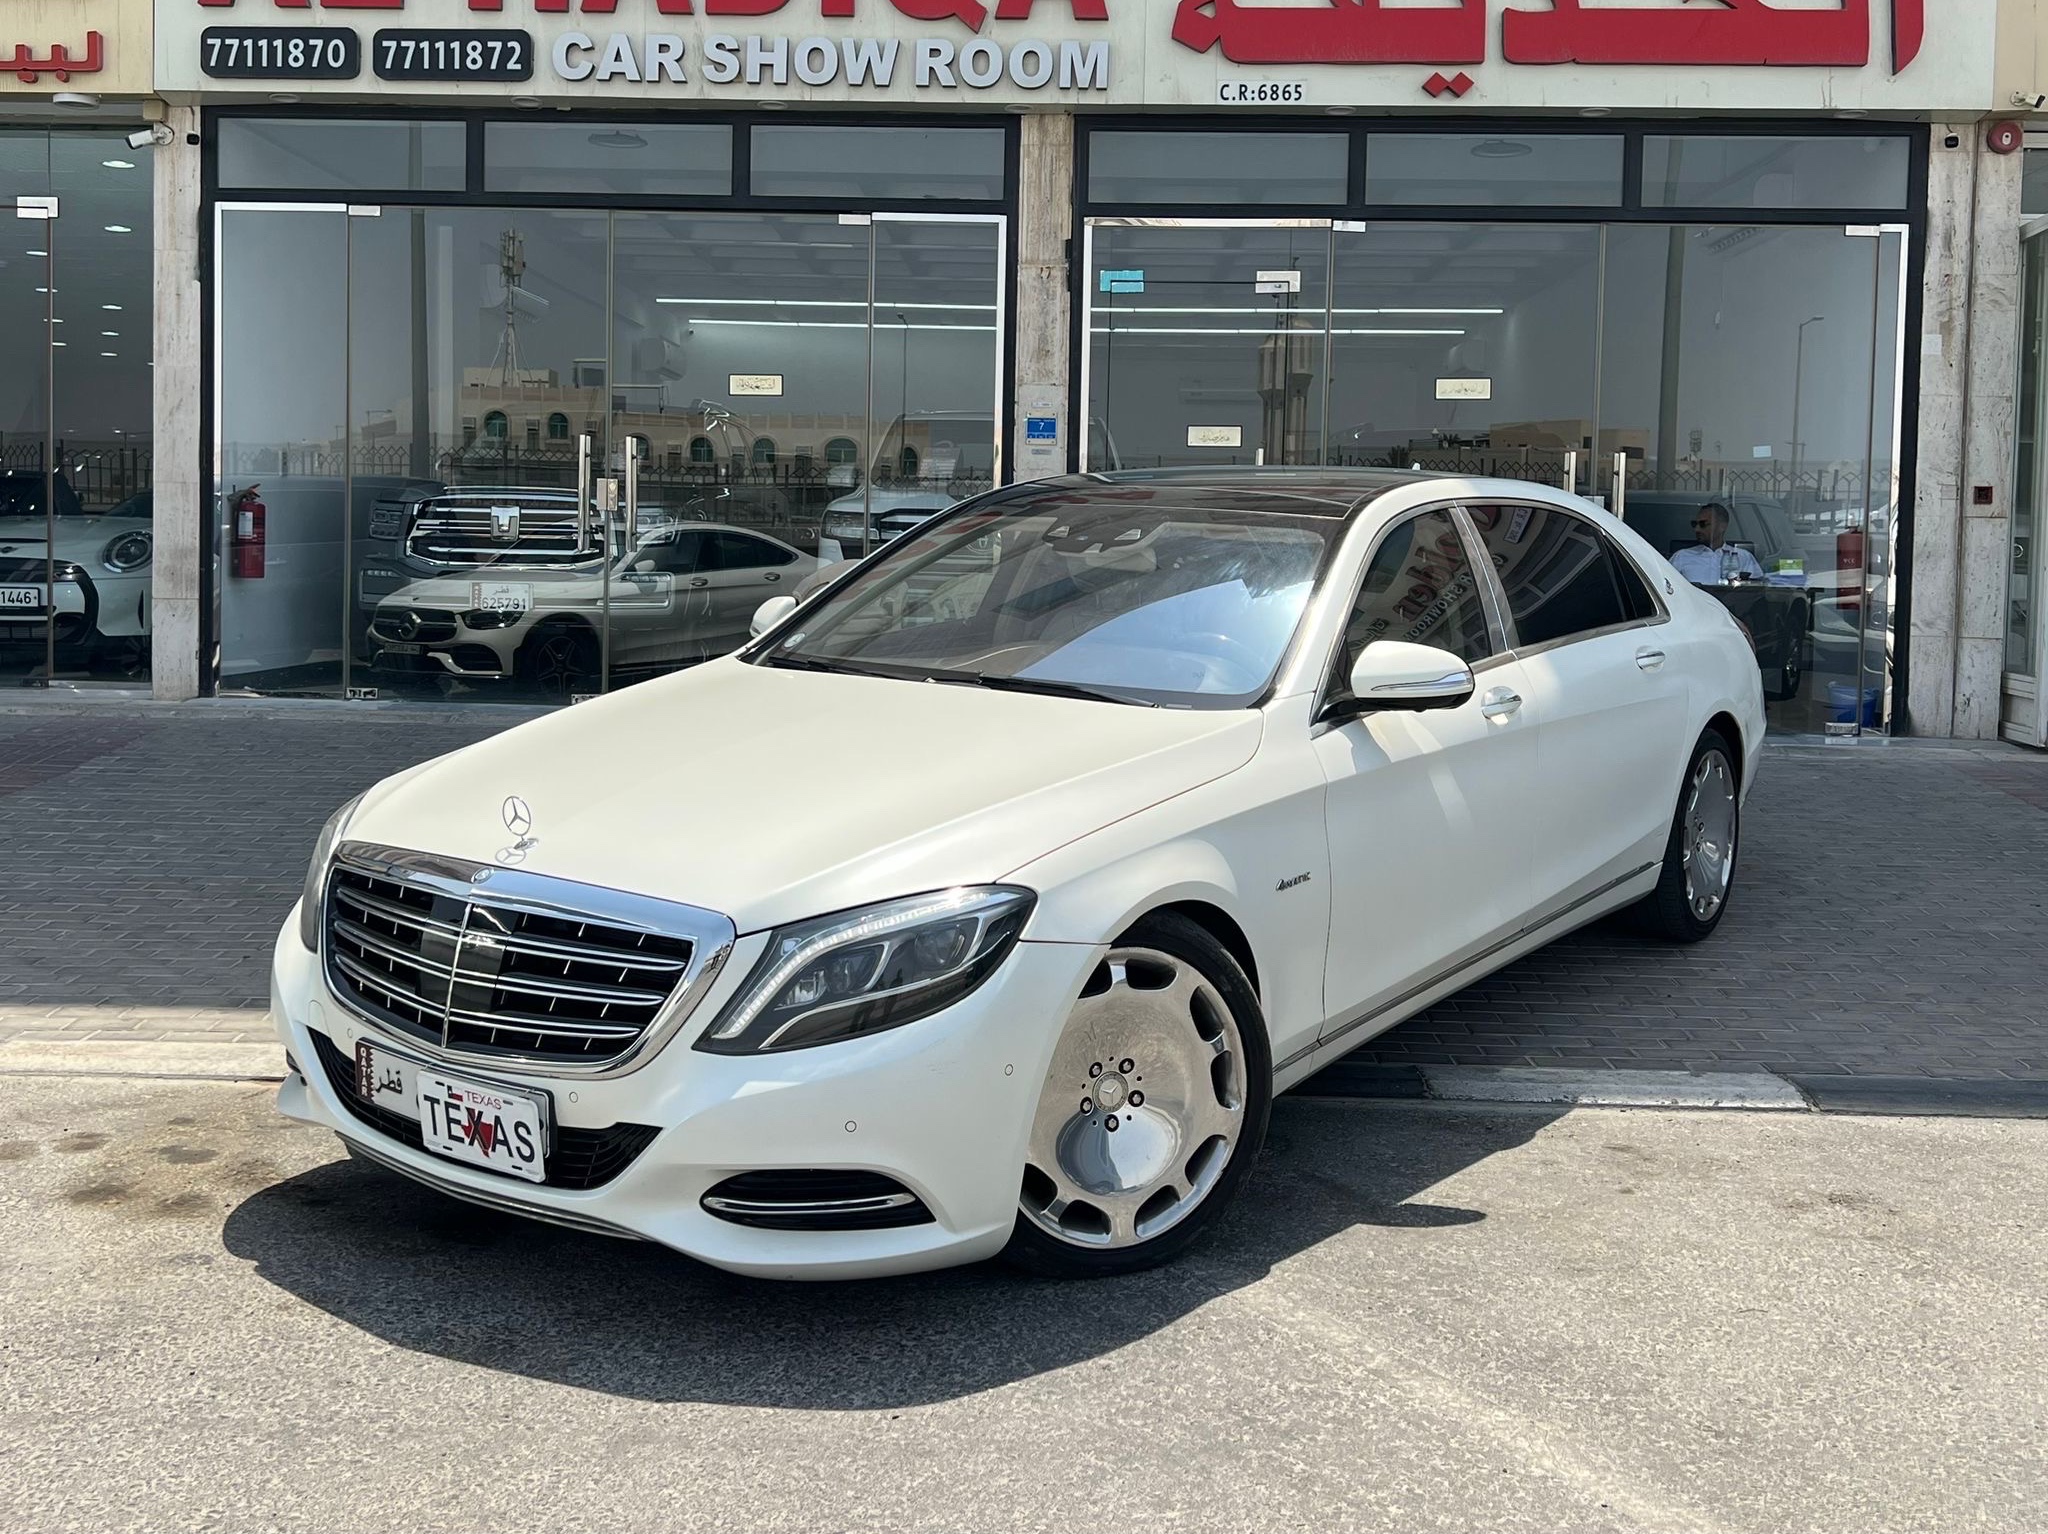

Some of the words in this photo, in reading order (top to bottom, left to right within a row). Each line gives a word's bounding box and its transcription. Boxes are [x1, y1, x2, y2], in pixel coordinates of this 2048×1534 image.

[206, 38, 346, 68] 77111870
[381, 40, 522, 71] 77111872
[552, 32, 687, 83] CAR
[701, 34, 900, 86] SHOW
[915, 38, 1109, 90] ROOM
[1220, 83, 1302, 101] C.R:6865
[1038, 421, 1046, 431] 7
[1, 590, 32, 604] 1446
[481, 597, 527, 610] 625791
[360, 1047, 368, 1097] QATAR
[375, 1068, 403, 1095] قطر
[465, 1090, 502, 1110] TEXAS
[423, 1094, 535, 1163] TEXAS
